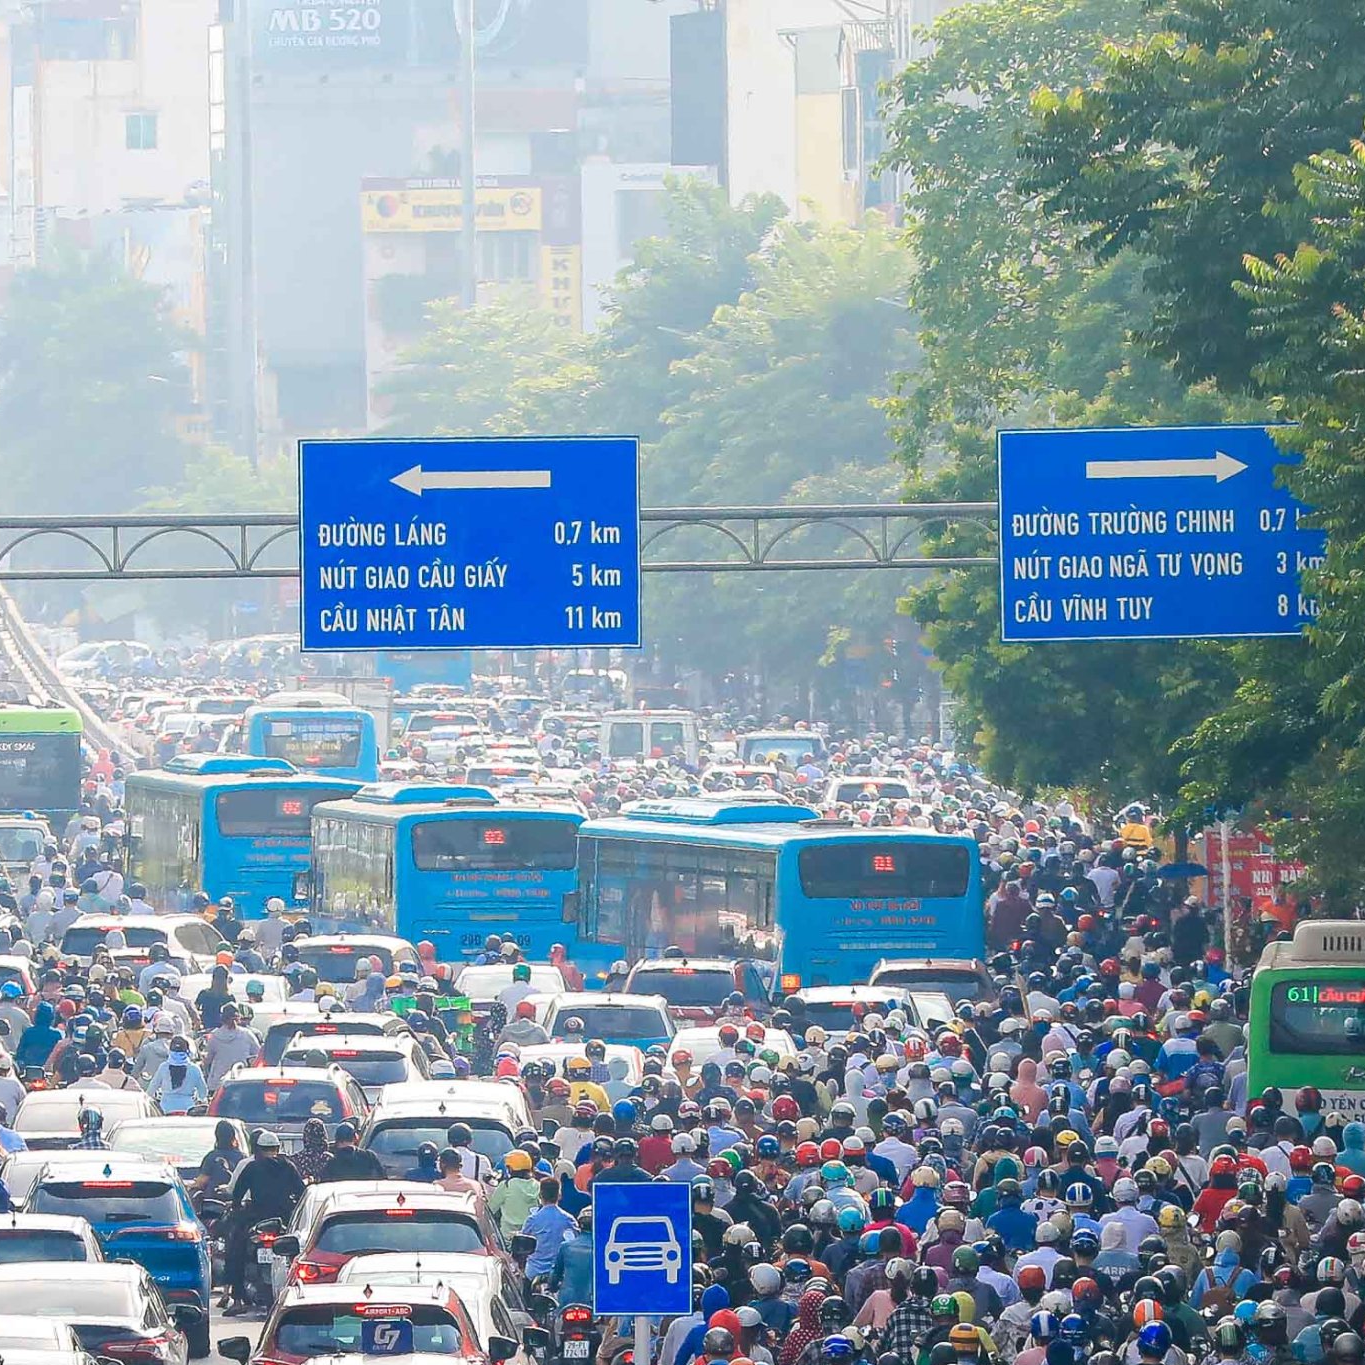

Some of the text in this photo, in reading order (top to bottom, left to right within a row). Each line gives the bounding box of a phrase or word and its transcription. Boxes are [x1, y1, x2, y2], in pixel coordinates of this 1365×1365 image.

[330, 9, 380, 31] 520
[318, 515, 386, 546] ĐƯỜNG
[395, 515, 447, 546] LÁNG
[591, 520, 621, 544] km
[1012, 506, 1080, 537] ĐƯỜNG
[1089, 504, 1167, 535] TRƯỜNG
[1176, 509, 1235, 533] CHINH
[320, 556, 621, 589] NÚT GIAO CẦU GIẤY 5 km
[1013, 549, 1053, 580] NÚT
[1059, 555, 1102, 579] GIAO
[1109, 548, 1149, 579] NGÃ
[1157, 552, 1183, 577] TƯ
[1191, 552, 1243, 581] VỌNG
[1276, 551, 1288, 574] 3
[320, 601, 622, 636] CẦU NHẬT TÂN 11 km
[1014, 591, 1052, 623] CẦU
[1063, 593, 1107, 621] VĨNH
[1116, 597, 1154, 620] TUY
[1278, 594, 1289, 617] 8
[1288, 986, 1310, 1002] 61
